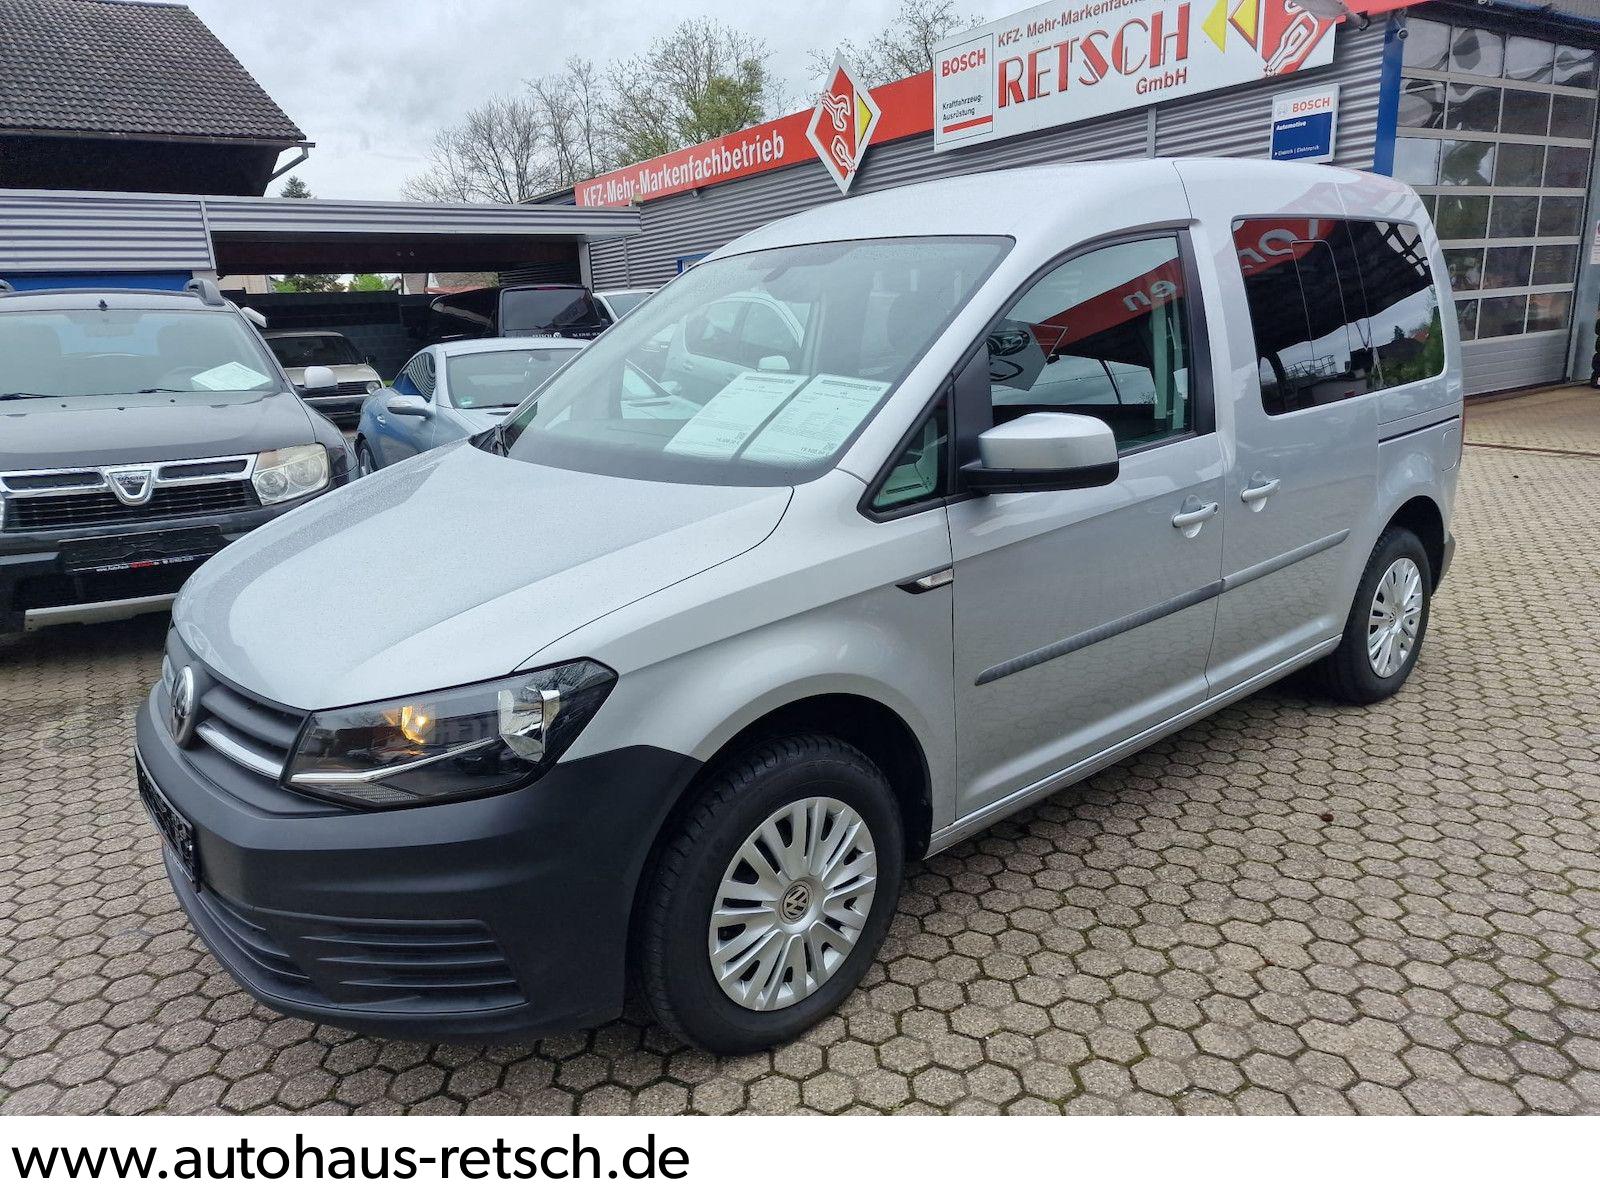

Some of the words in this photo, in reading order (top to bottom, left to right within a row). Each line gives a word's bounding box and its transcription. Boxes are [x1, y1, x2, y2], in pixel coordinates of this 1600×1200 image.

[998, 27, 1023, 48] KFZ-
[942, 48, 986, 77] BOSCH
[998, 1, 1191, 109] RETSCH
[1135, 66, 1188, 95] GmbH
[942, 94, 984, 111] Kraftfahrzeug-
[1292, 96, 1331, 113] BOSCH
[942, 107, 976, 121] Ausrüstung
[1276, 120, 1307, 131] Automotive
